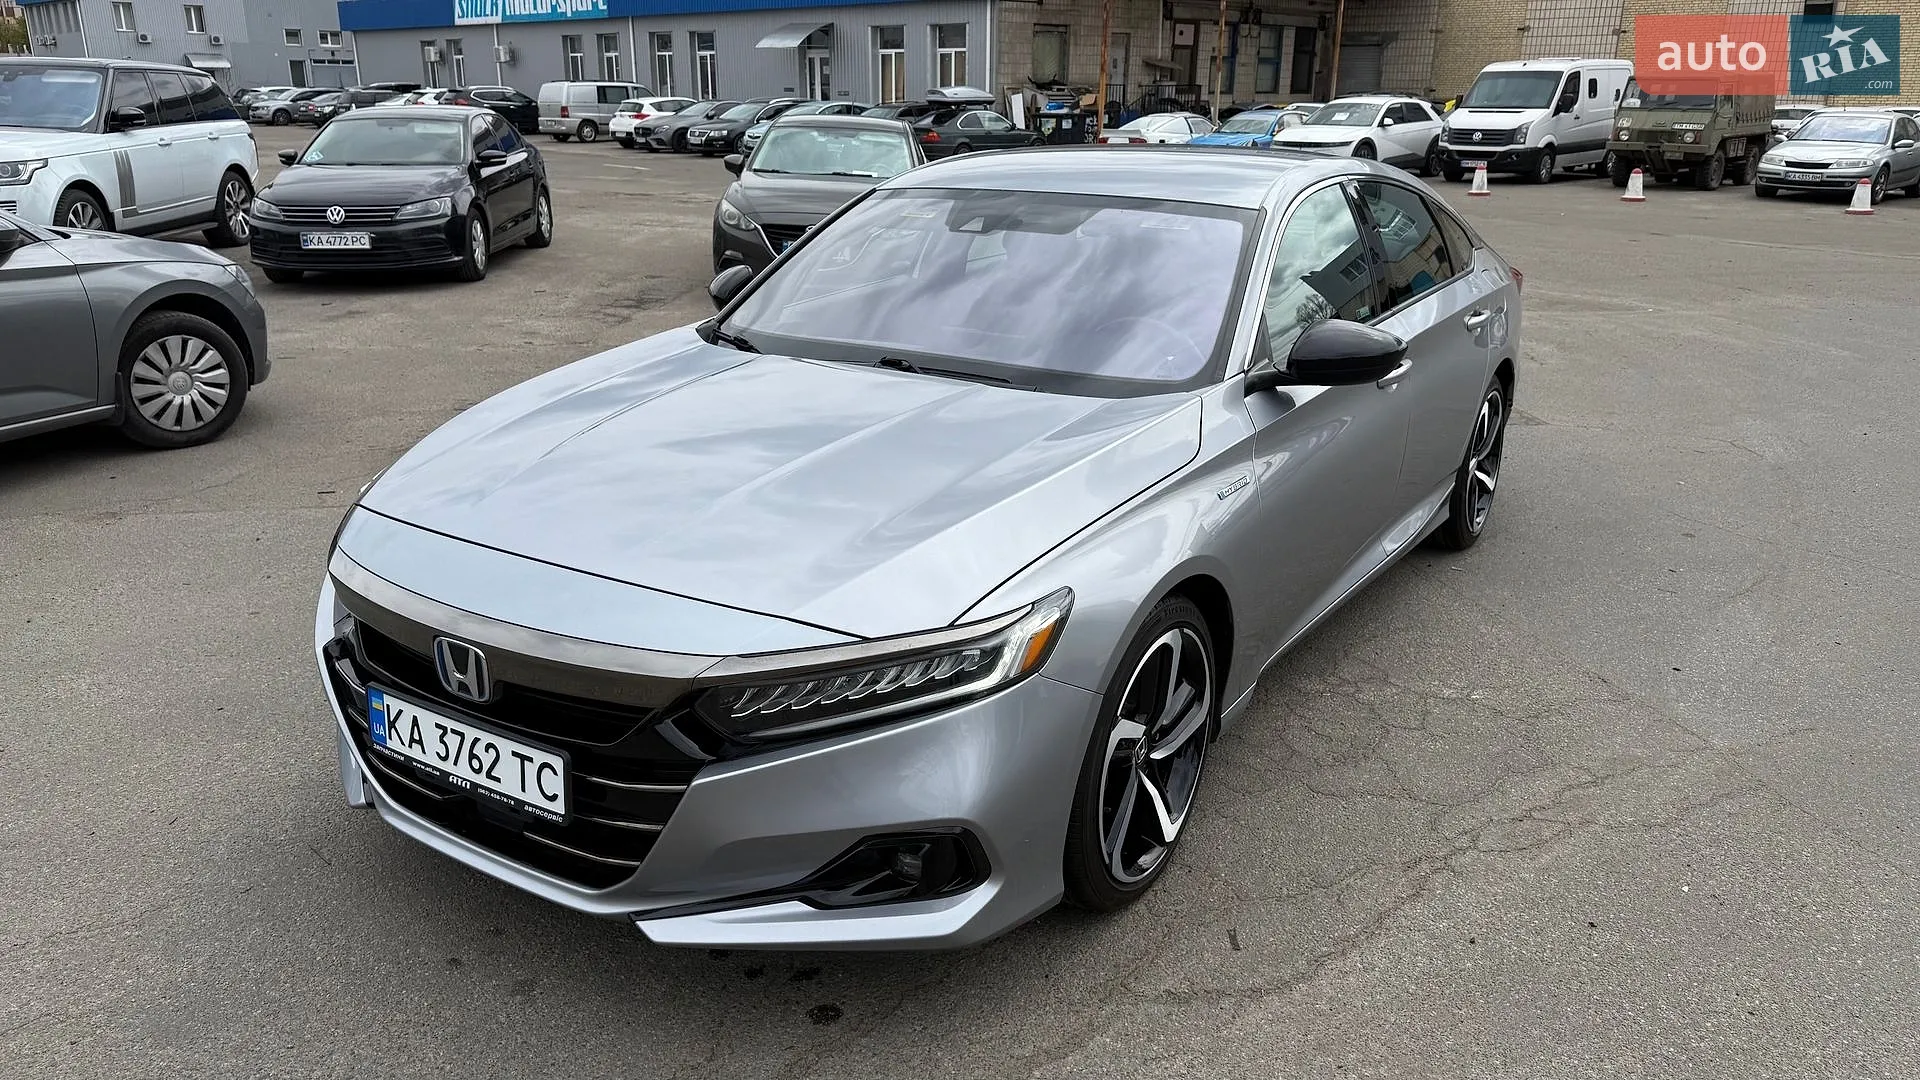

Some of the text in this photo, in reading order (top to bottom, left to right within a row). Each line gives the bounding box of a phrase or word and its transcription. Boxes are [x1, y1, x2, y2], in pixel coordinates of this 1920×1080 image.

[308, 235, 366, 246] KA 4772 PC
[373, 722, 386, 737] UA
[386, 703, 560, 803] KA 3762 TC
[523, 804, 563, 823] автосервіс
